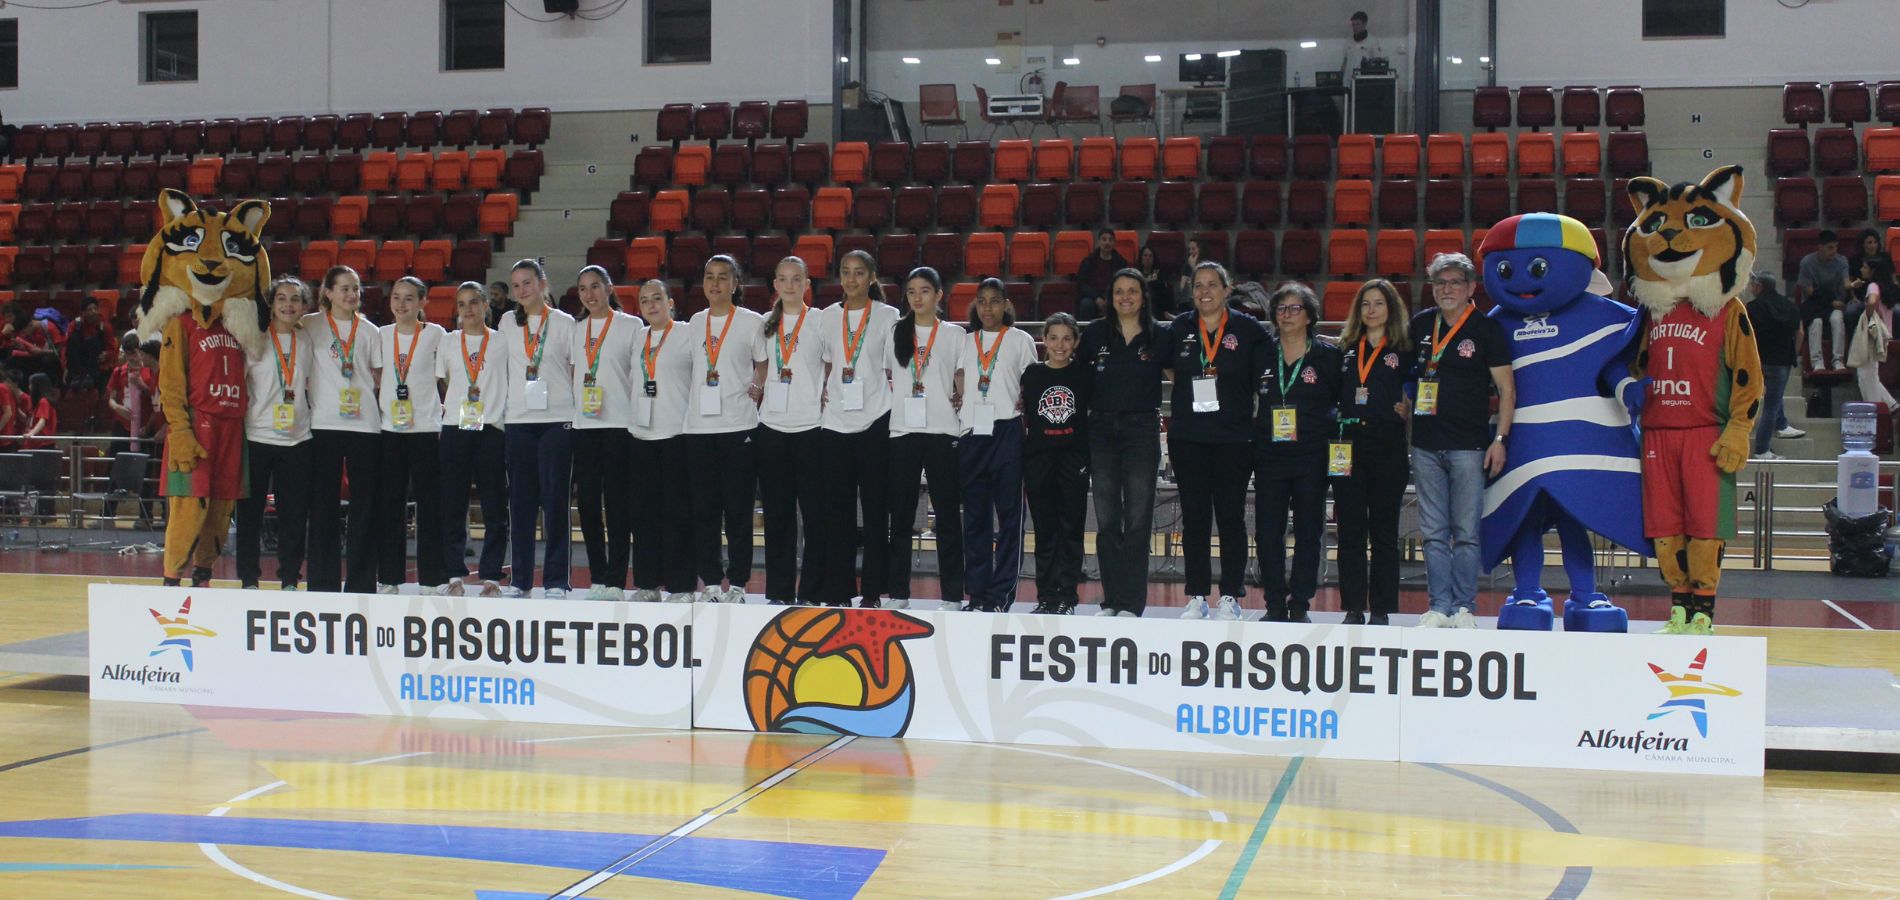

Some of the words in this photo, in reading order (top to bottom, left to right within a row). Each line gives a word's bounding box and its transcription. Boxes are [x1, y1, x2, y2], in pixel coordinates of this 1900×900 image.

[1691, 114, 1701, 124] H
[630, 134, 639, 143] H
[1703, 149, 1713, 159] G
[587, 165, 596, 174] G
[564, 209, 571, 219] F
[199, 334, 240, 352] PORTUG
[223, 355, 229, 376] 1
[1667, 346, 1673, 370] 1
[209, 383, 240, 399] una
[1744, 490, 1755, 502] A
[246, 609, 368, 657] FESTA
[376, 626, 396, 648] DO
[403, 615, 702, 669] BASQUETEBOL
[101, 663, 181, 685] Albufeira
[990, 633, 1138, 685] FESTA
[1148, 652, 1172, 676] DO
[1181, 640, 1537, 701] BASQUETEBOL
[400, 672, 535, 706] ALBUFEIRA
[1176, 703, 1339, 740] ALBUFEIRA
[1576, 728, 1689, 754] Albufeira
[1644, 754, 1683, 763] CÂMARA
[1686, 756, 1736, 765] MUNICIPAL
